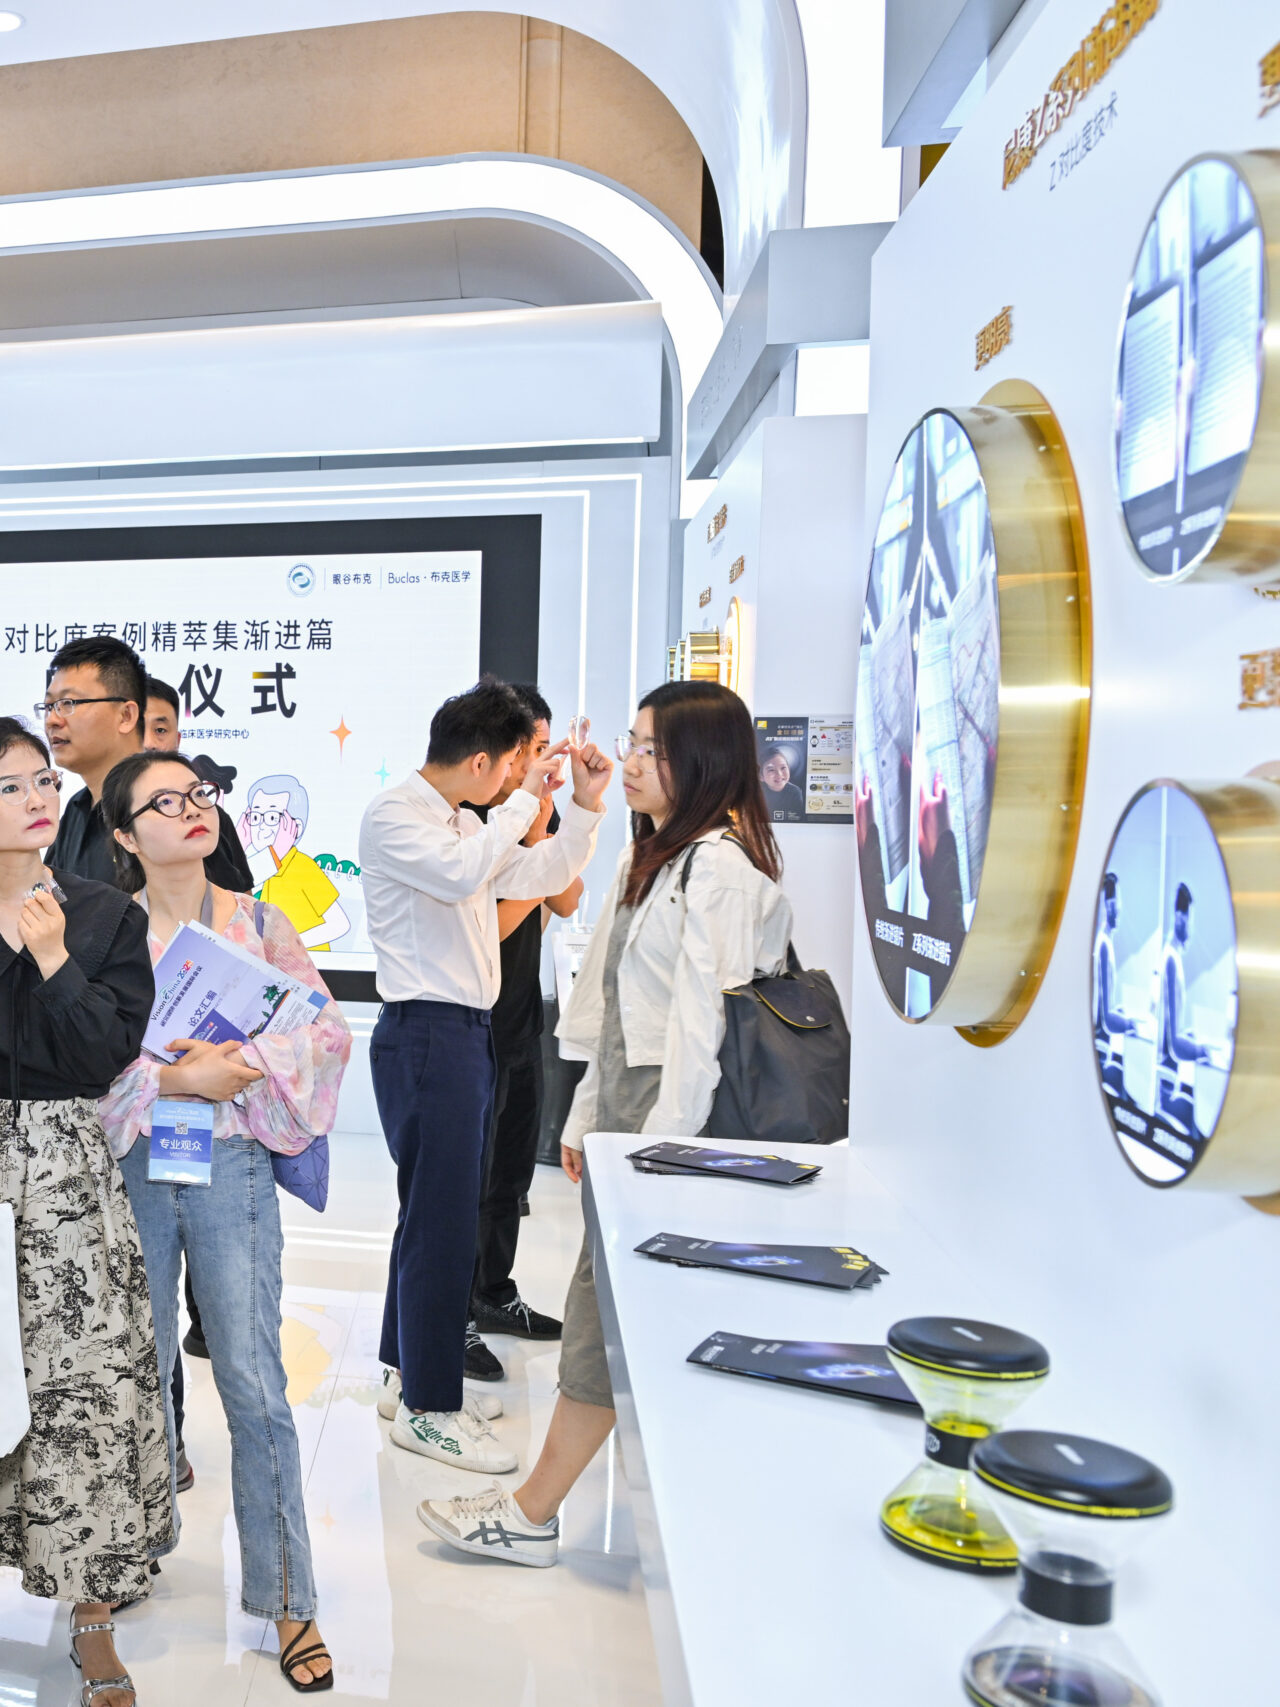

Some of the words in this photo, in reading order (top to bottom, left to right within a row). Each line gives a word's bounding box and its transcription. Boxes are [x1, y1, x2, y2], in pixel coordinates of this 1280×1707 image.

[332, 573, 372, 585] 眼谷布克
[388, 572, 420, 584] Buclas
[430, 571, 471, 583] 布克医学
[150, 1001, 167, 1021] Vision
[188, 990, 218, 1027] 论文汇编
[160, 1138, 202, 1151] 专业观众
